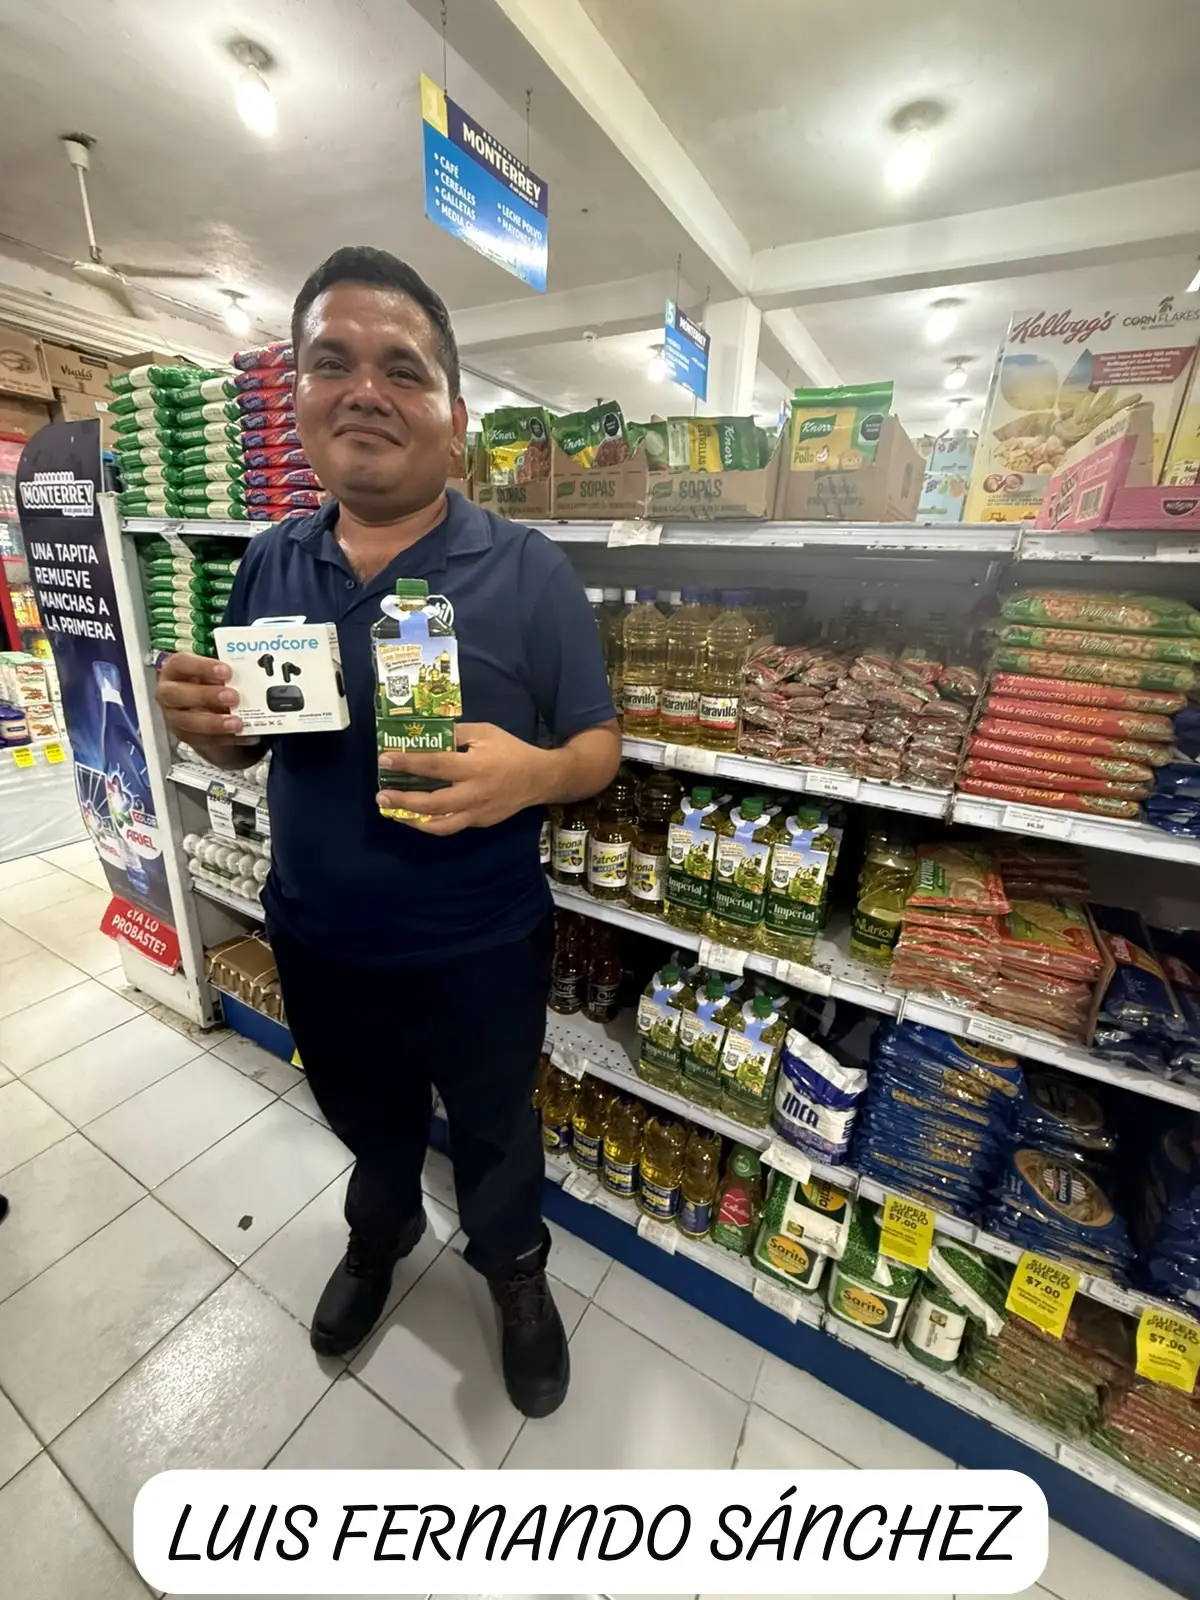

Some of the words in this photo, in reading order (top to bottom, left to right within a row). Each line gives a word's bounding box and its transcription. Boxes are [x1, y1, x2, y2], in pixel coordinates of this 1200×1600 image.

[440, 155, 459, 179] CAFÉ
[463, 122, 541, 201] MONTERREY
[440, 172, 476, 206] CEREALES
[441, 188, 476, 220] GALLETAS
[441, 203, 464, 228] MEDIA
[502, 204, 522, 227] LECHE
[522, 219, 543, 241] POLVO
[667, 300, 675, 325] 5
[1122, 314, 1157, 326] CORN
[1158, 309, 1200, 322] FLAKES
[1009, 309, 1116, 344] Kellogg's
[490, 430, 516, 441] Knorr
[802, 422, 832, 433] Knorr
[564, 438, 586, 449] Knorr
[724, 424, 736, 466] Knorr
[793, 451, 814, 464] Pollo
[22, 483, 92, 506] MONTERREY
[580, 481, 616, 498] SOPAS
[679, 479, 723, 499] SOPAS
[30, 542, 53, 561] UNA
[55, 543, 99, 564] TAPITA
[35, 567, 92, 589] REMUEVE
[40, 591, 95, 614] MANCHAS
[99, 597, 110, 616] A
[44, 613, 58, 631] LA
[226, 634, 319, 653] soundcore
[1000, 685, 1018, 694] MÁS
[1019, 688, 1066, 700] PRODUCTO
[1067, 694, 1108, 705] GRATIS
[995, 704, 1013, 714] MÁS
[1014, 708, 1062, 721] PRODUCTO
[1063, 714, 1104, 727] GRATIS
[384, 731, 443, 753] Imperial
[1007, 729, 1053, 742] PRODUCTO
[1053, 734, 1096, 748] GRATIS
[988, 743, 1034, 757] PRODUCTO
[1034, 748, 1073, 764] GRATIS
[966, 778, 982, 787] MÁS
[982, 781, 1026, 795] PRODUCTO
[1026, 787, 1065, 800] GRATIS
[134, 813, 157, 828] COLOR
[559, 839, 583, 849] trona
[632, 863, 654, 872] rona
[668, 875, 703, 897] Imperial
[716, 890, 753, 911] Imperial
[127, 907, 144, 924] ¿YA
[144, 915, 160, 932] LO
[774, 903, 815, 922] Imperial
[112, 914, 167, 956] PROBASTE?
[889, 1206, 929, 1226] PRECIO
[893, 1200, 928, 1218] SUPER
[888, 1212, 917, 1230] $7.00
[769, 1238, 807, 1267] Sarita
[1025, 1263, 1071, 1290] PRECIO
[1031, 1259, 1071, 1282] SUPER
[1026, 1275, 1060, 1299] $7.00
[843, 1288, 886, 1317] Sarita
[1145, 1318, 1200, 1345] PRECIO
[1152, 1314, 1198, 1337] SUPER
[1148, 1332, 1187, 1354] $7.00
